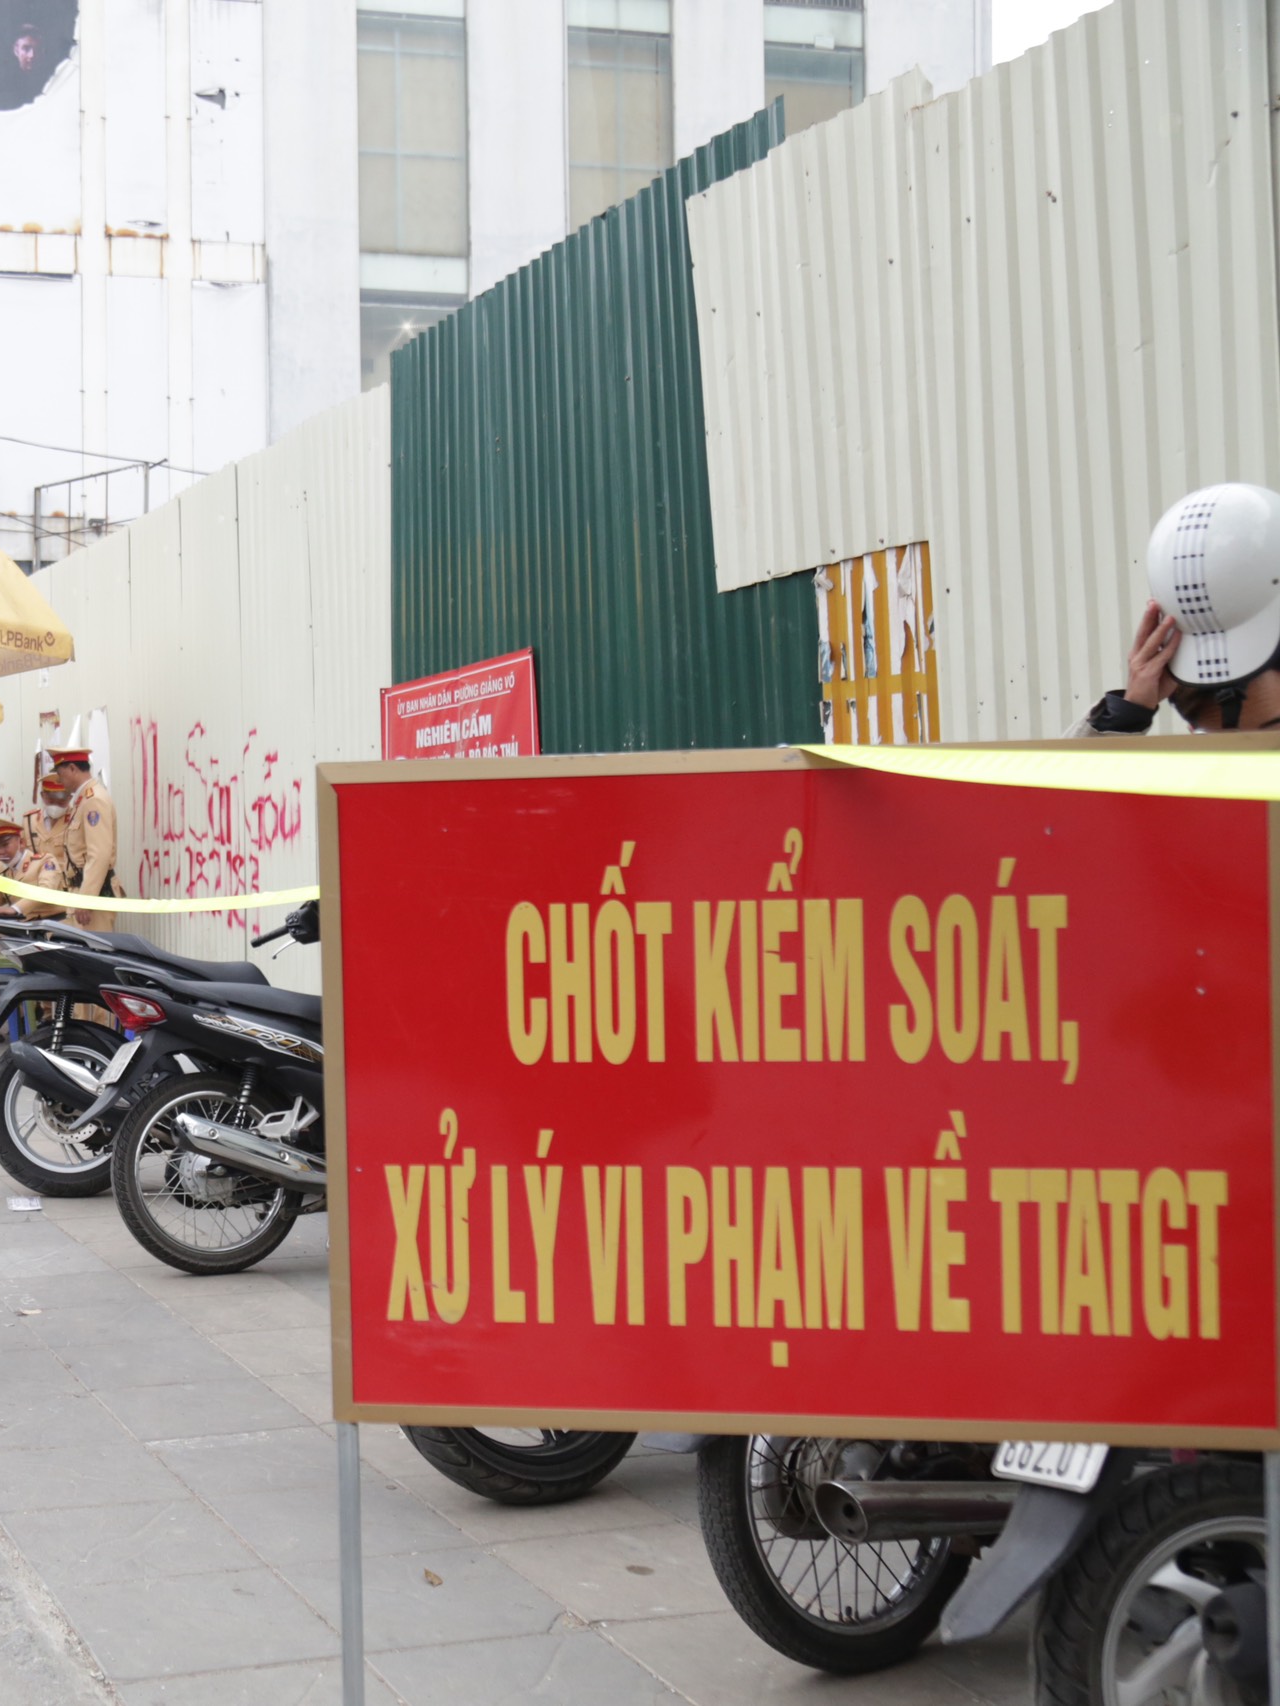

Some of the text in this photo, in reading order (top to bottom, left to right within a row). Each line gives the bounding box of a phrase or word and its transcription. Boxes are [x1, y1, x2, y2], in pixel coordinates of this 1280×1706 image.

[0, 629, 44, 652] LPBank
[406, 699, 419, 713] BAN
[420, 691, 437, 709] NHÂN
[437, 690, 452, 706] DÂN
[480, 674, 503, 696] GIẢNG
[461, 708, 492, 740] CẤM
[503, 827, 1080, 1086] CHỐT KIỂM SOÁT,
[384, 1107, 1229, 1368] XỬ LÝ VI PHẠM VỀ TTATGT
